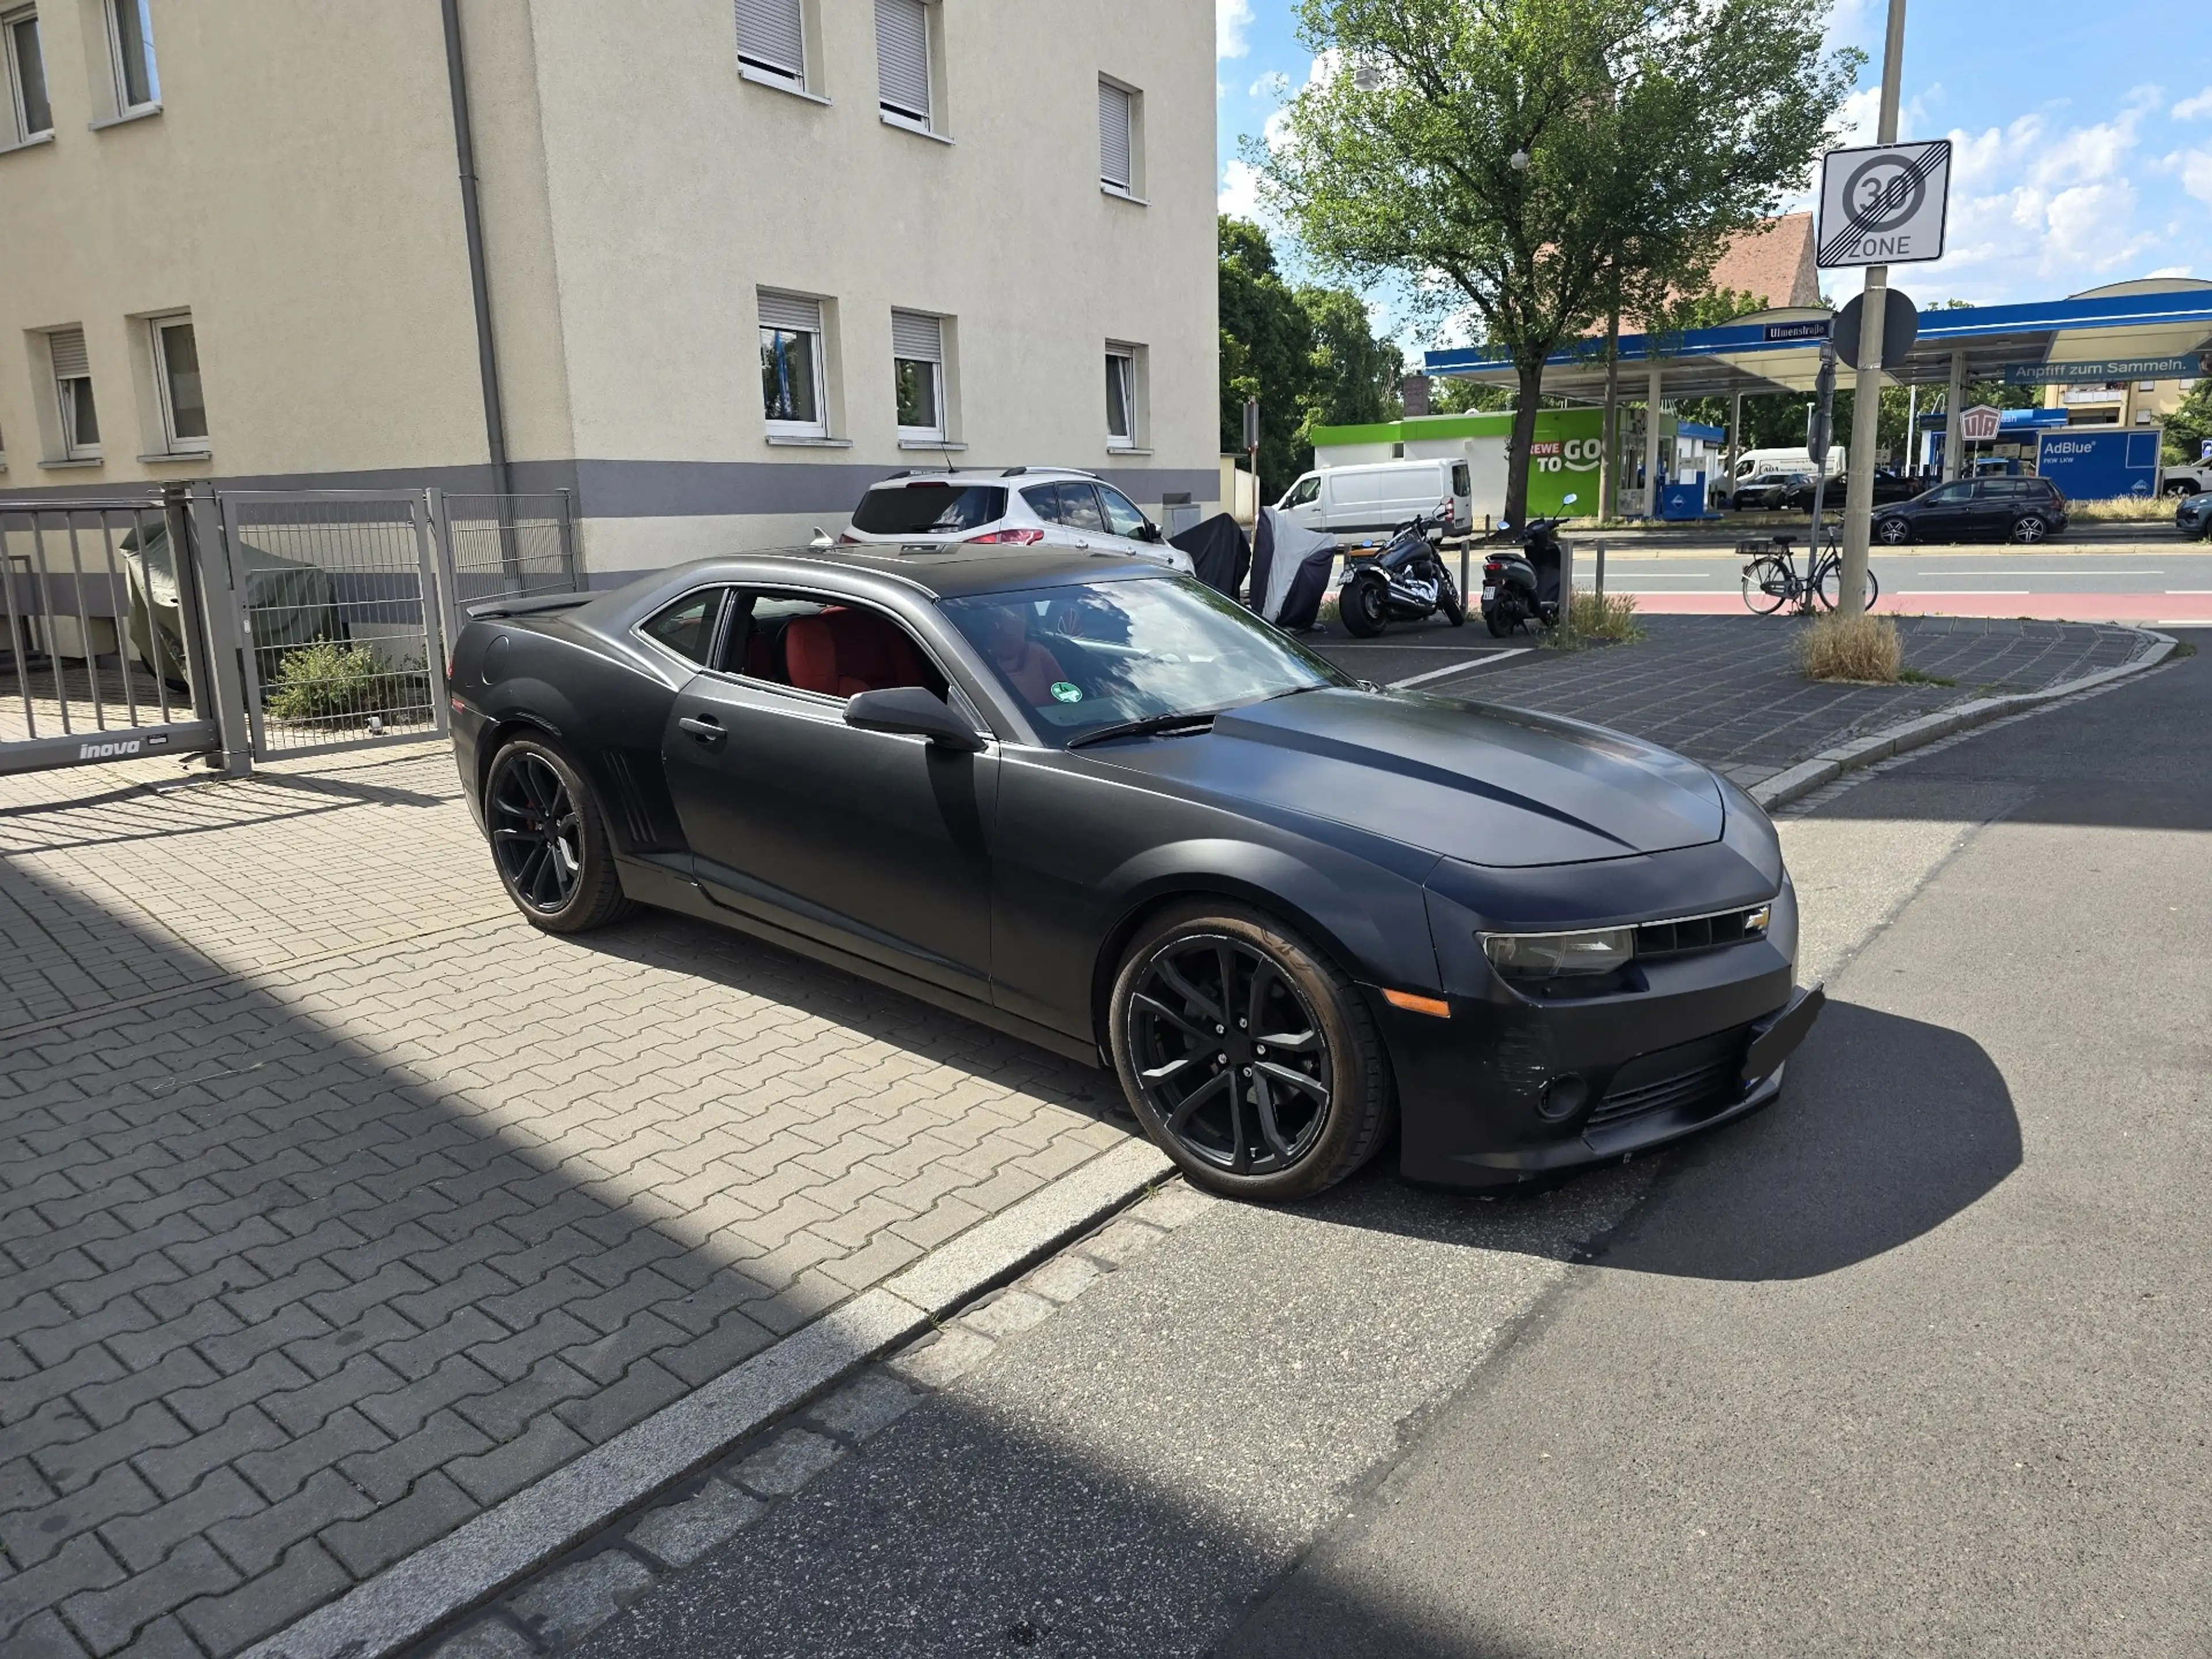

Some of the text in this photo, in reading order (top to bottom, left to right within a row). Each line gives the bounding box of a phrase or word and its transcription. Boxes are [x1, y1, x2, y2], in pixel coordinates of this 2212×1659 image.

[1859, 175, 1906, 211] 30
[1848, 236, 1911, 257] ZONE
[1770, 324, 1824, 338] Ulmenstraße
[2016, 359, 2187, 378] Anpfiff zum Sammeln.
[1964, 415, 1998, 437] UTA
[2000, 415, 2017, 423] ash
[1564, 438, 1601, 460] GO
[1537, 456, 1562, 472] TO
[79, 741, 140, 759] inova
